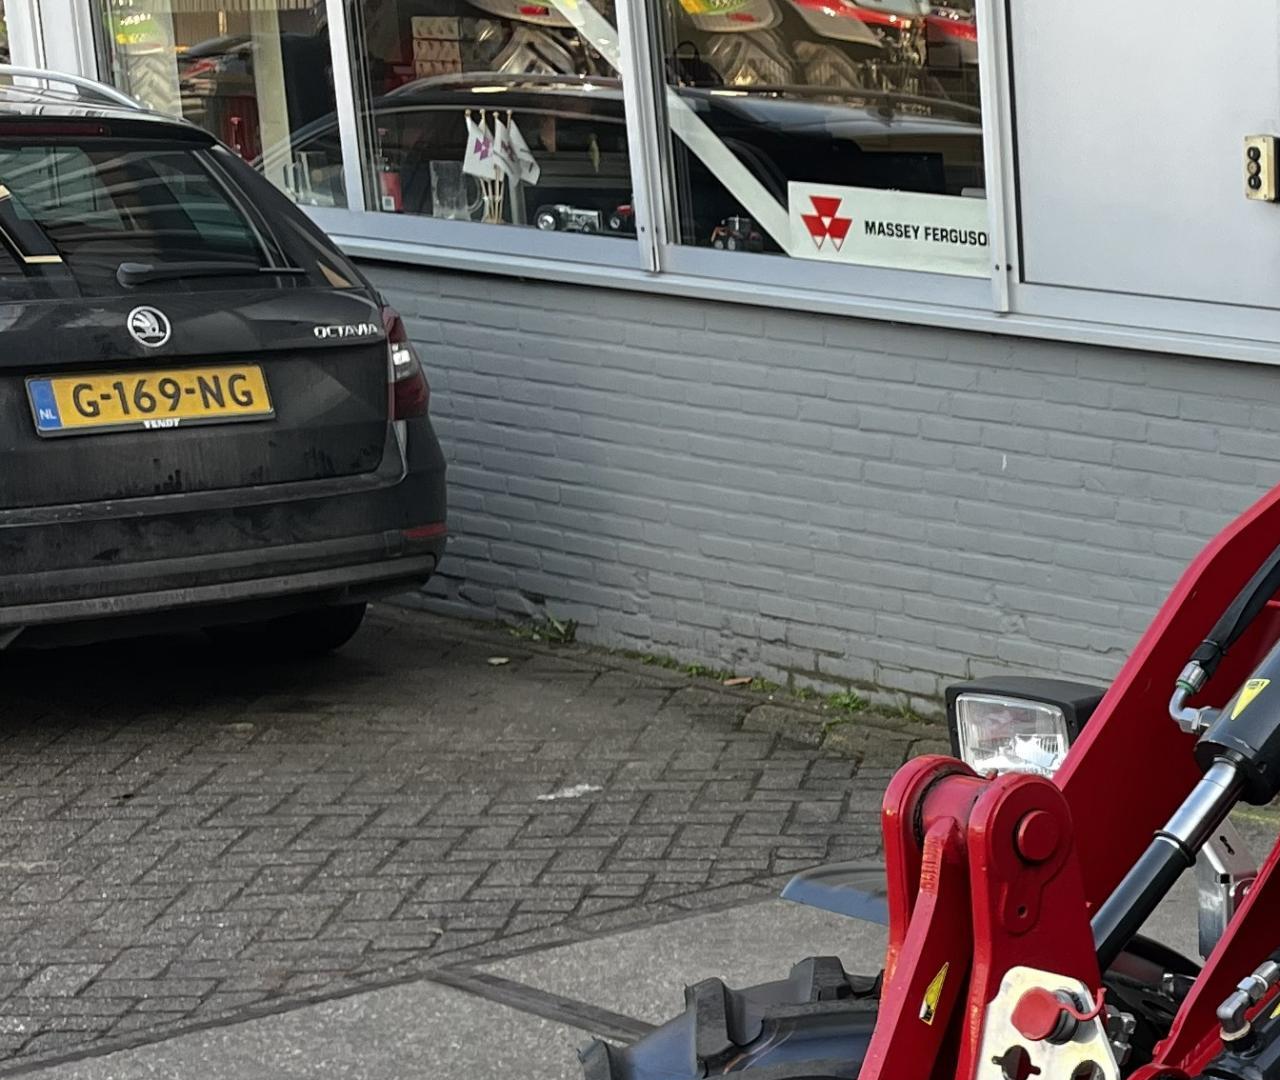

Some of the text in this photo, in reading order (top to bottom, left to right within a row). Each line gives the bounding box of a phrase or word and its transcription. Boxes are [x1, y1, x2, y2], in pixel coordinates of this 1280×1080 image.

[864, 220, 990, 246] MASSEY FERGUSO
[313, 323, 378, 339] OCTAVIA
[72, 373, 254, 418] G-169-NG
[39, 409, 57, 420] NL
